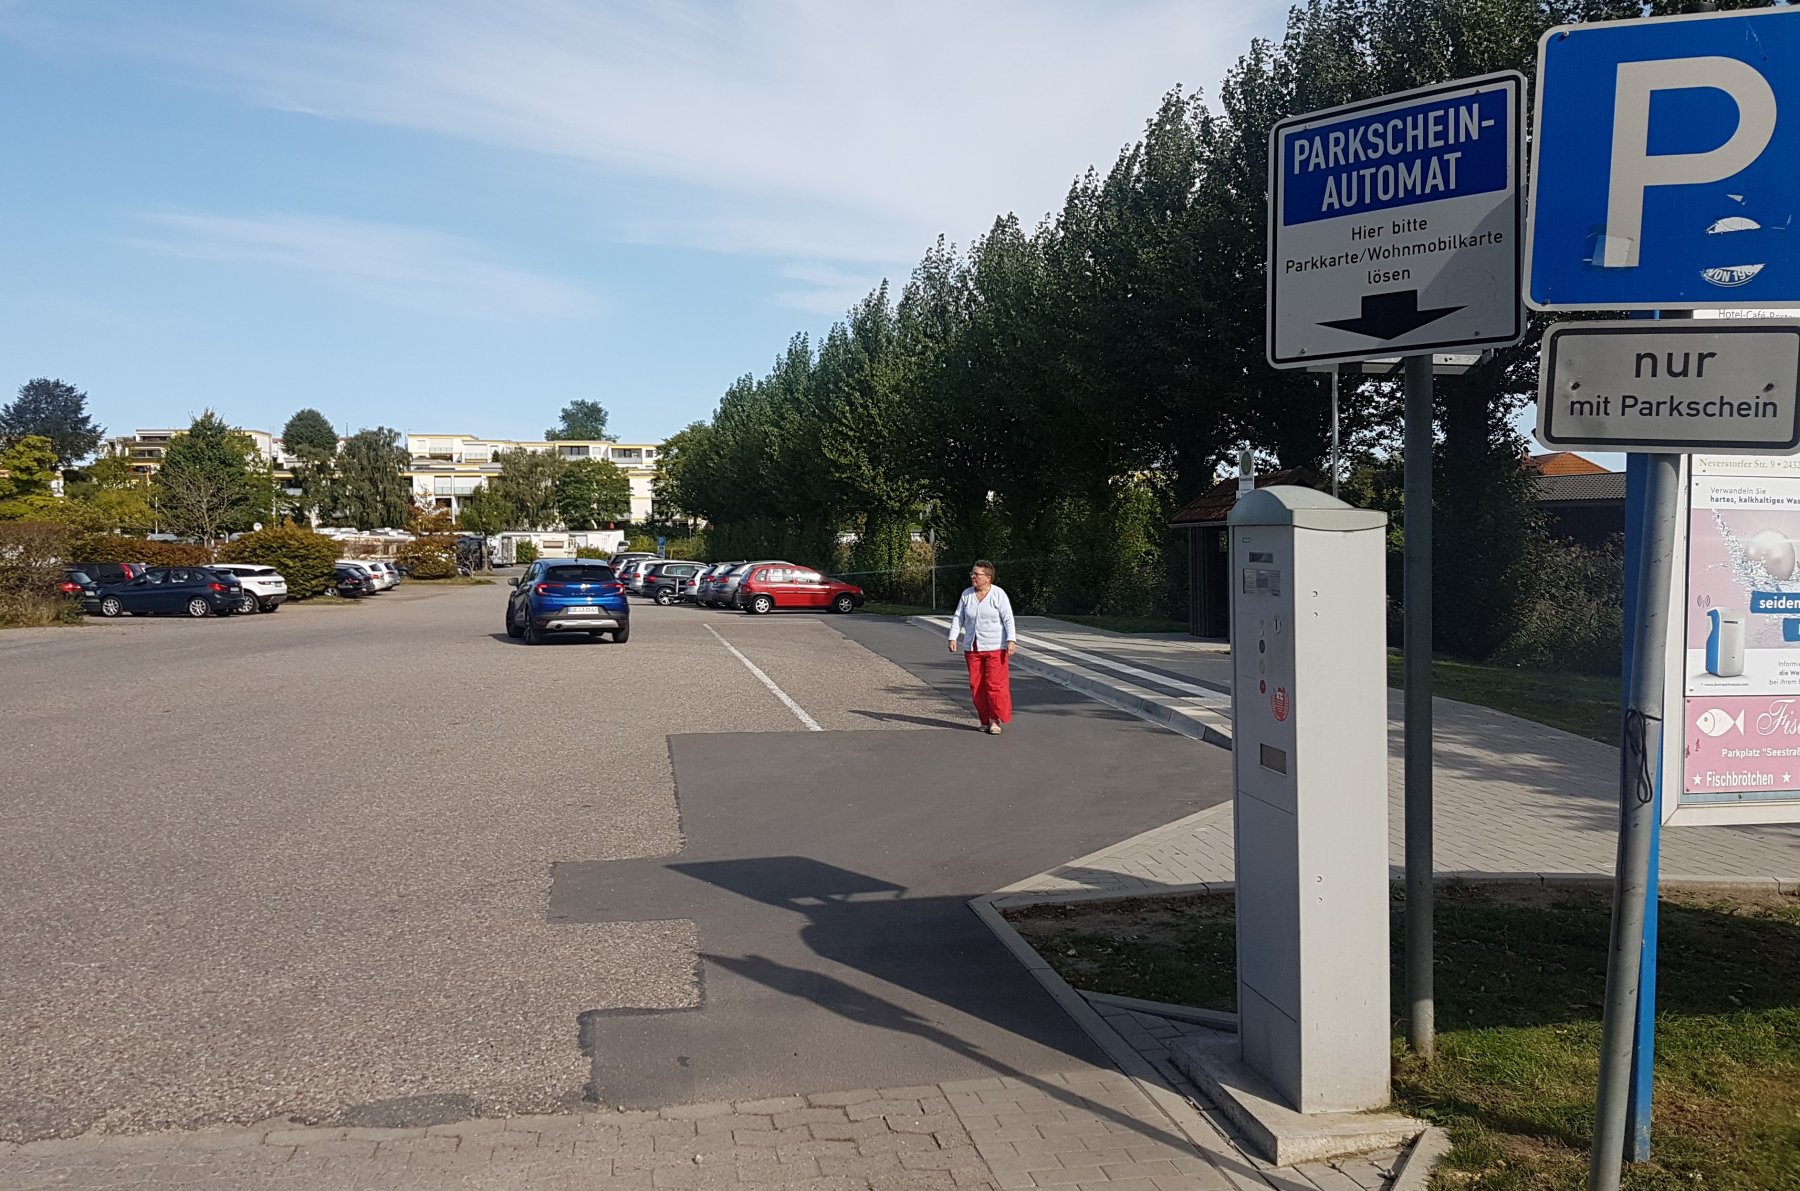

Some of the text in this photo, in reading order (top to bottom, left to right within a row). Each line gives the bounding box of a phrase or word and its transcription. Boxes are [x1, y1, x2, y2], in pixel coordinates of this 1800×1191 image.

[1294, 103, 1495, 175] PARKSCHEIN-
[1604, 56, 1777, 268] P
[1321, 152, 1462, 212] AUTOMAT
[1351, 219, 1428, 241] Hier bitte
[1285, 231, 1503, 274] Parkkarte/Wohnmobilkarte
[1367, 268, 1411, 285] lösen
[1634, 352, 1717, 378] nur
[1569, 394, 1778, 418] mit Parkschein
[1699, 458, 1752, 467] Neverstorfer
[1754, 459, 1768, 469] Str.
[1770, 461, 1775, 469] 9
[1710, 496, 1737, 504] hartes,
[1738, 497, 1784, 506] kalkhaltiges
[1711, 487, 1754, 495] Verwandeln
[1721, 748, 1761, 759] Parkplatz
[1706, 770, 1774, 787] Fischbrötchen
